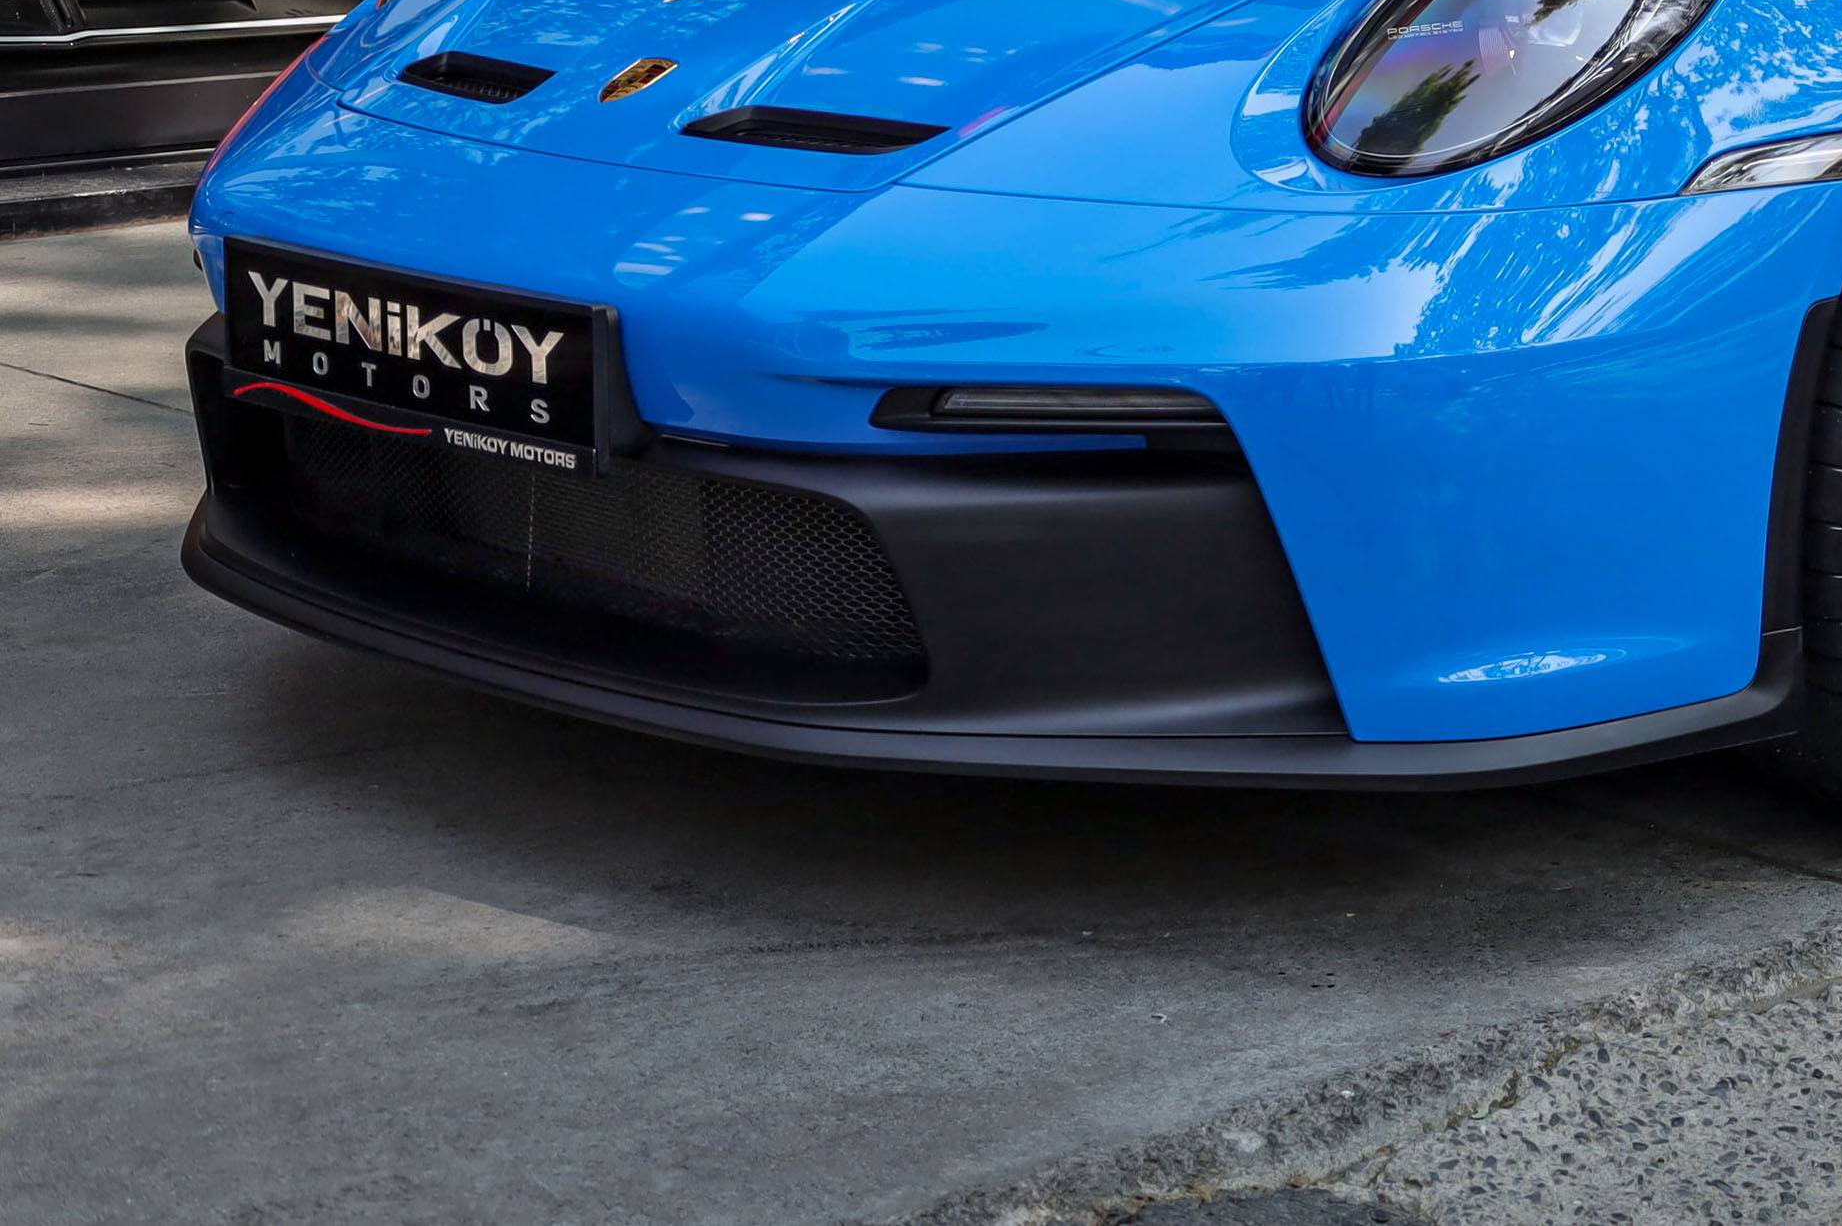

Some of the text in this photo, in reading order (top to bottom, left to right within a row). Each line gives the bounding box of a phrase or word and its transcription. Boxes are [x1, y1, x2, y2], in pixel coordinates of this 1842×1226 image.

[1387, 20, 1464, 36] PORSCHE
[263, 339, 551, 425] MOTORS
[510, 442, 577, 469] MOTORS
